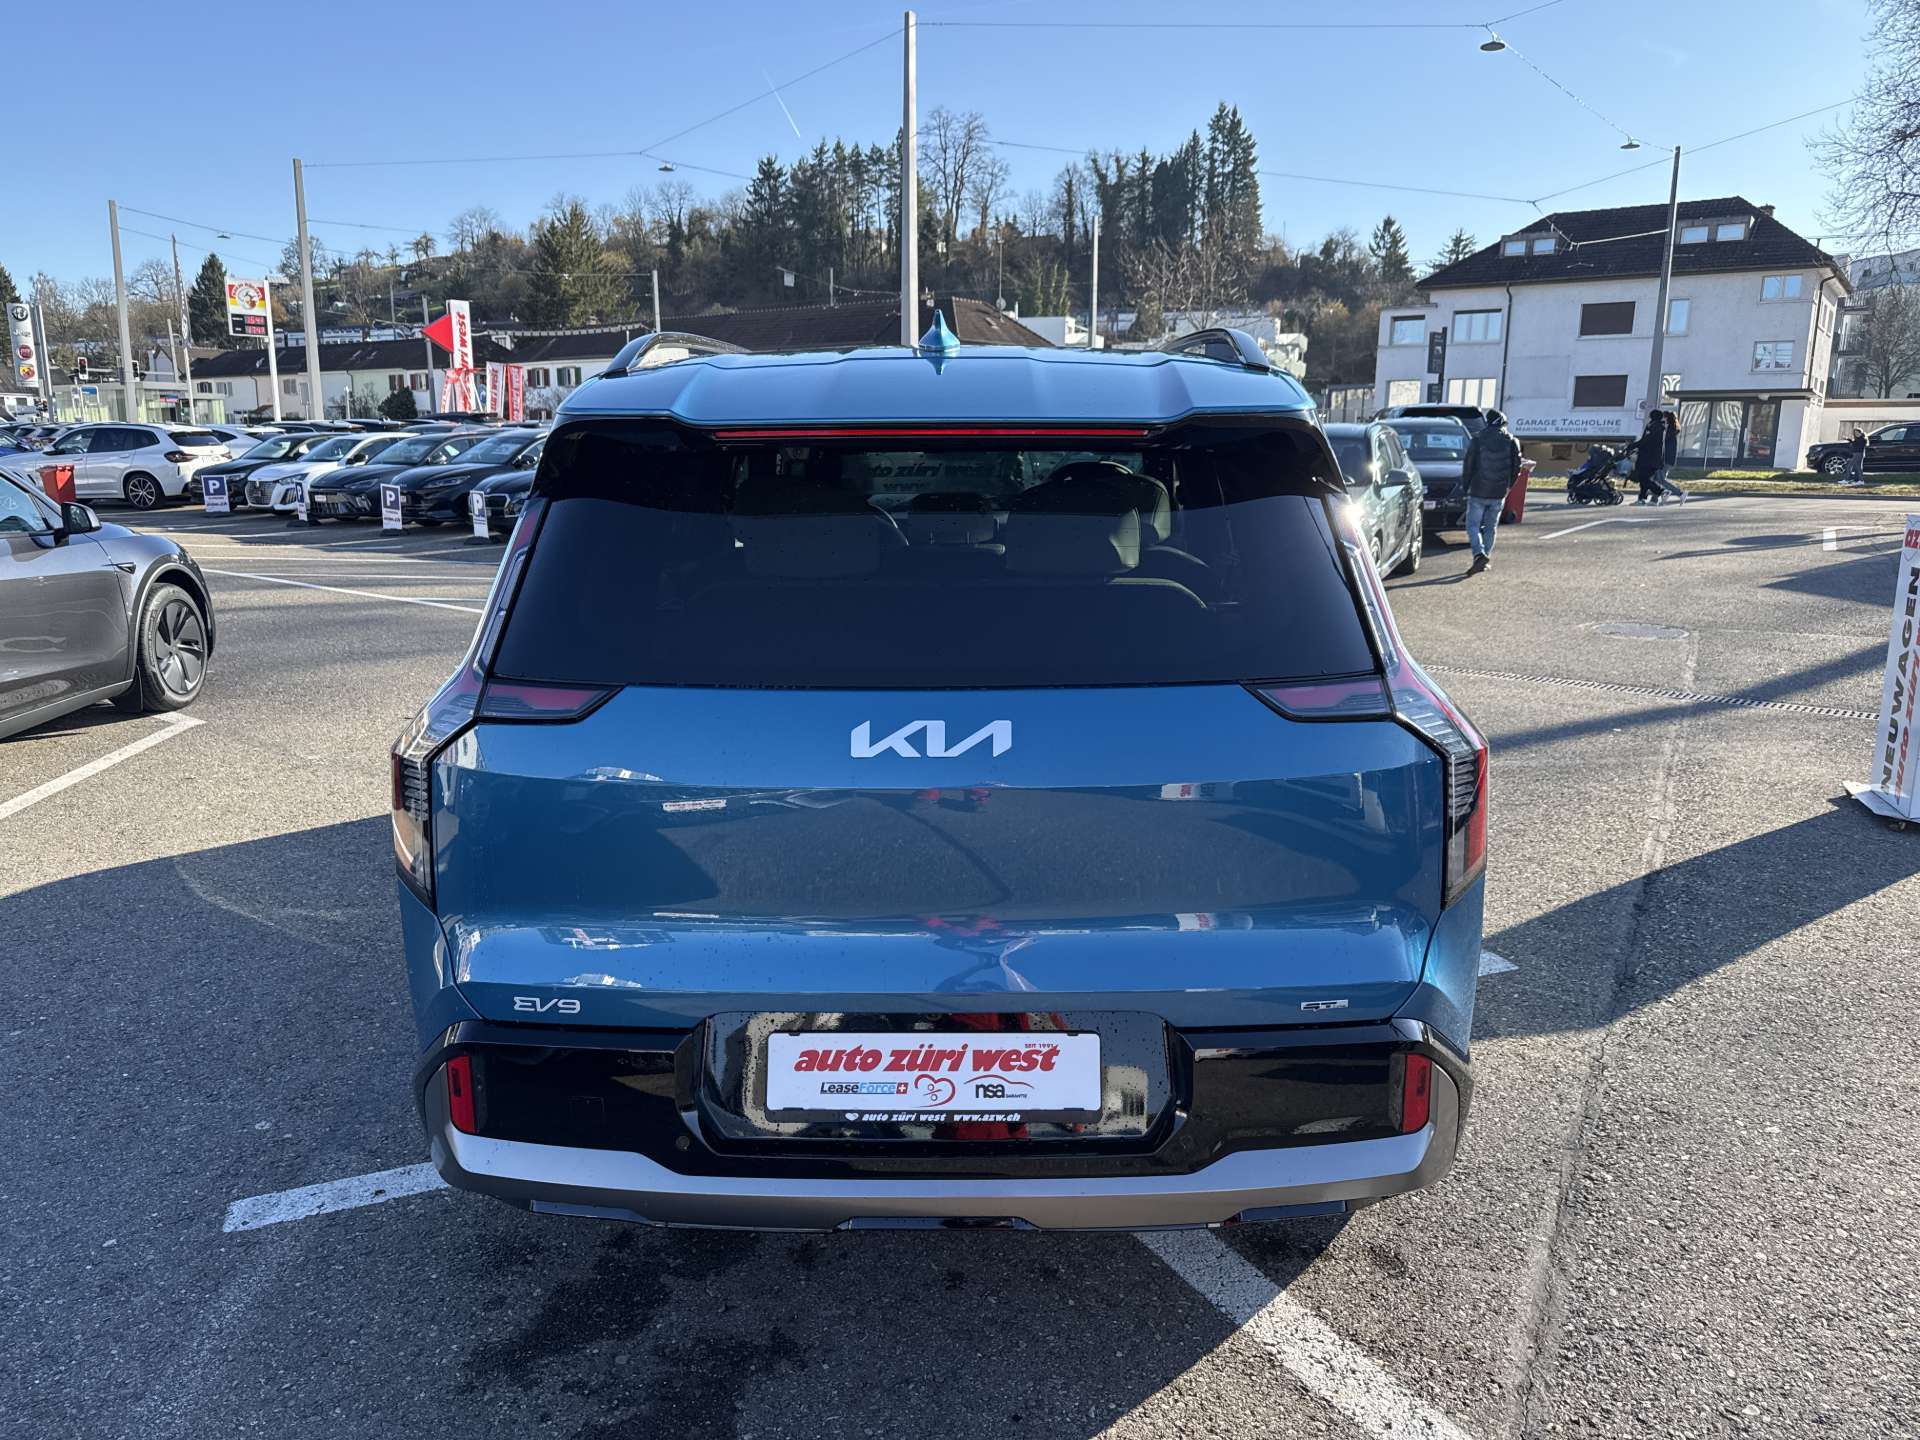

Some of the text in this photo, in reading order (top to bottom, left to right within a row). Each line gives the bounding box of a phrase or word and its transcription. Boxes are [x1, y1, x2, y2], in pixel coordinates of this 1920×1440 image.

[455, 311, 467, 348] west
[1516, 418, 1622, 426] GARAGE TACHOLINE
[208, 480, 220, 494] P
[386, 490, 396, 506] P
[1881, 567, 1920, 794] NEUWAGEN
[513, 996, 581, 1014] EV9
[793, 1043, 1060, 1072] auto züri west
[975, 1083, 1005, 1098] nsa
[862, 1112, 1021, 1122] auto züri west www.azw.ch
